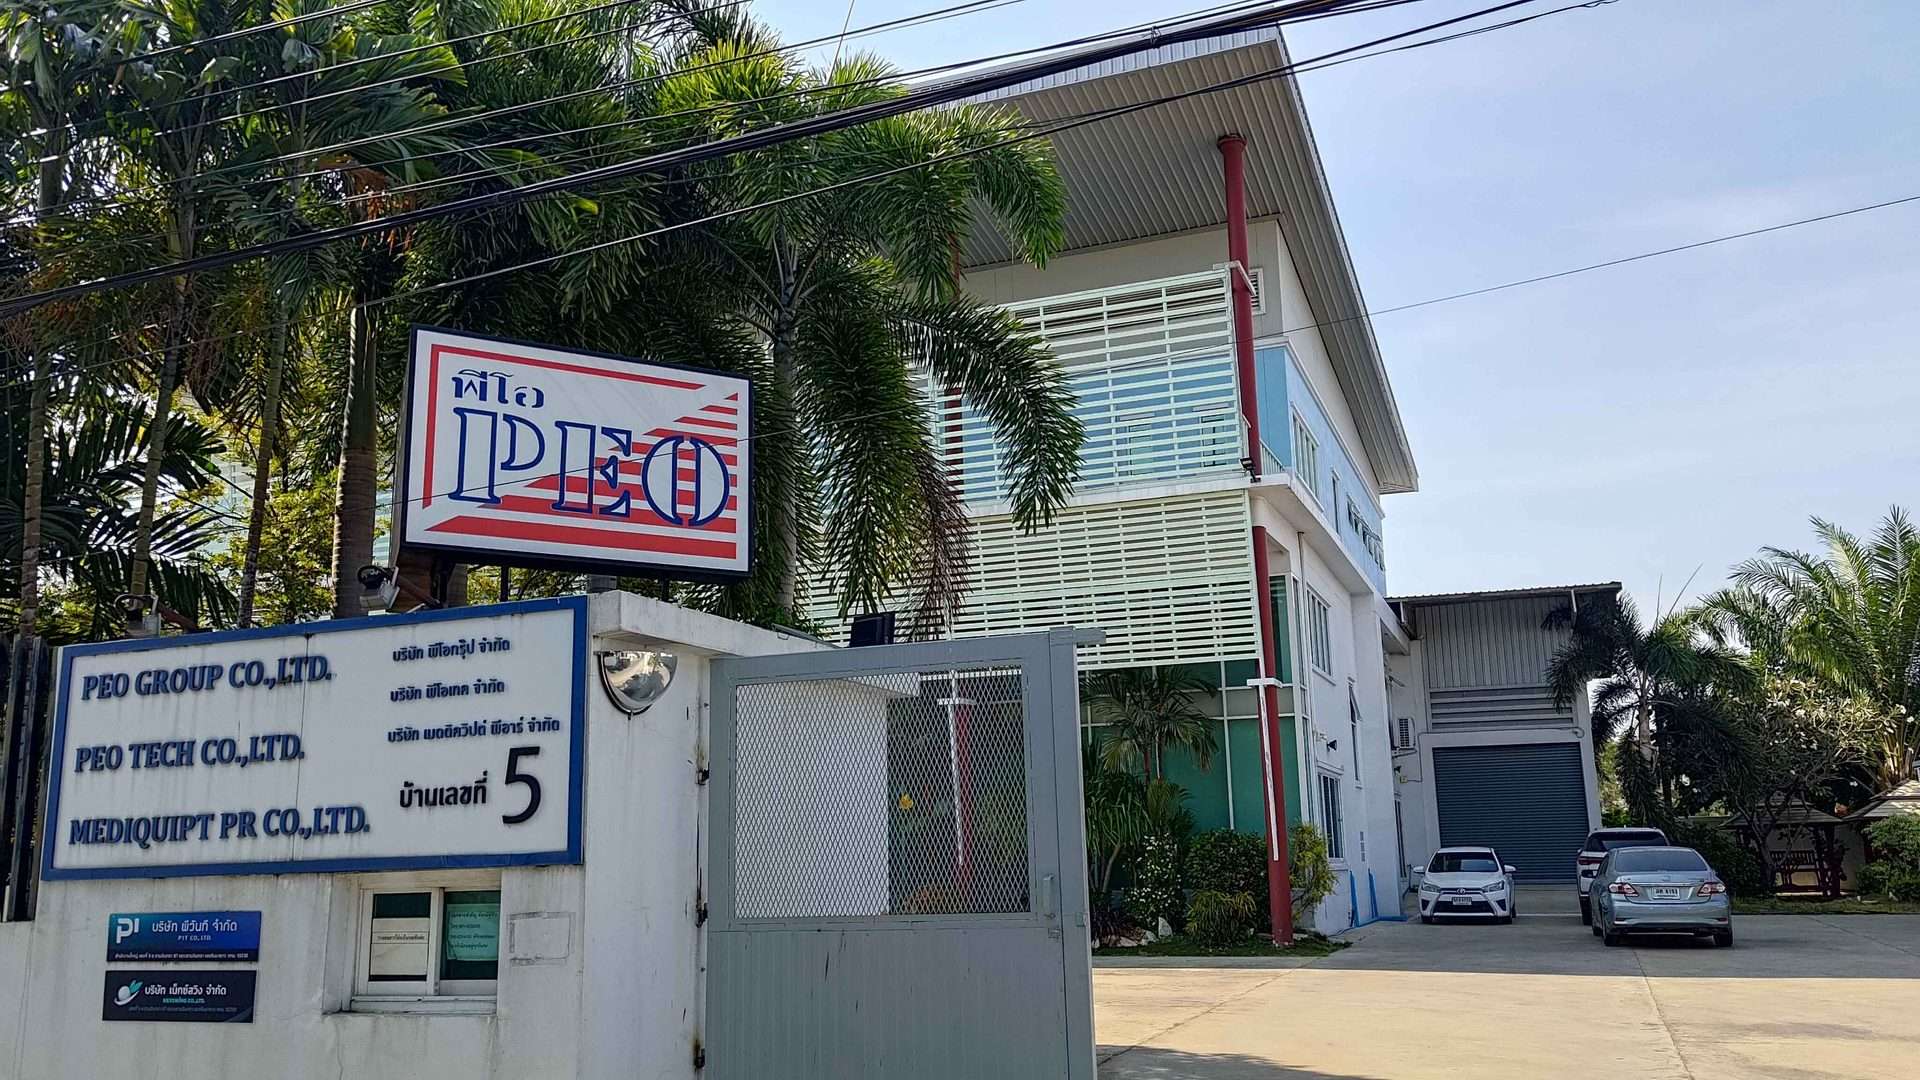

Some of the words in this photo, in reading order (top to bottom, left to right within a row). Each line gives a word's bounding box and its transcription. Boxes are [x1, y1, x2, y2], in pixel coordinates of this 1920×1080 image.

[448, 407, 730, 527] PEO
[392, 645, 424, 662] บริษัท
[478, 637, 511, 653] จำกัด
[81, 673, 130, 700] PEO
[135, 664, 224, 696] GROUP
[228, 655, 332, 690] CO.,LTD.
[390, 686, 422, 702] บริษัท
[473, 678, 505, 694] จำกัด
[388, 726, 420, 743] บริษัท
[527, 717, 560, 733] จำกัด
[74, 745, 124, 773] PEO
[128, 740, 196, 769] TECH
[200, 734, 305, 768] CO.,LTD.
[399, 770, 488, 808] บ้านเลขที่
[502, 746, 542, 824] 5
[69, 813, 215, 849] MEDIQUIPT
[218, 811, 258, 839] PR
[263, 806, 371, 839] CO.,LTD.
[152, 920, 178, 933] บริษัท
[212, 918, 238, 932] จำกัด
[144, 984, 166, 996] บริษัท
[206, 984, 227, 996] จำกัด
